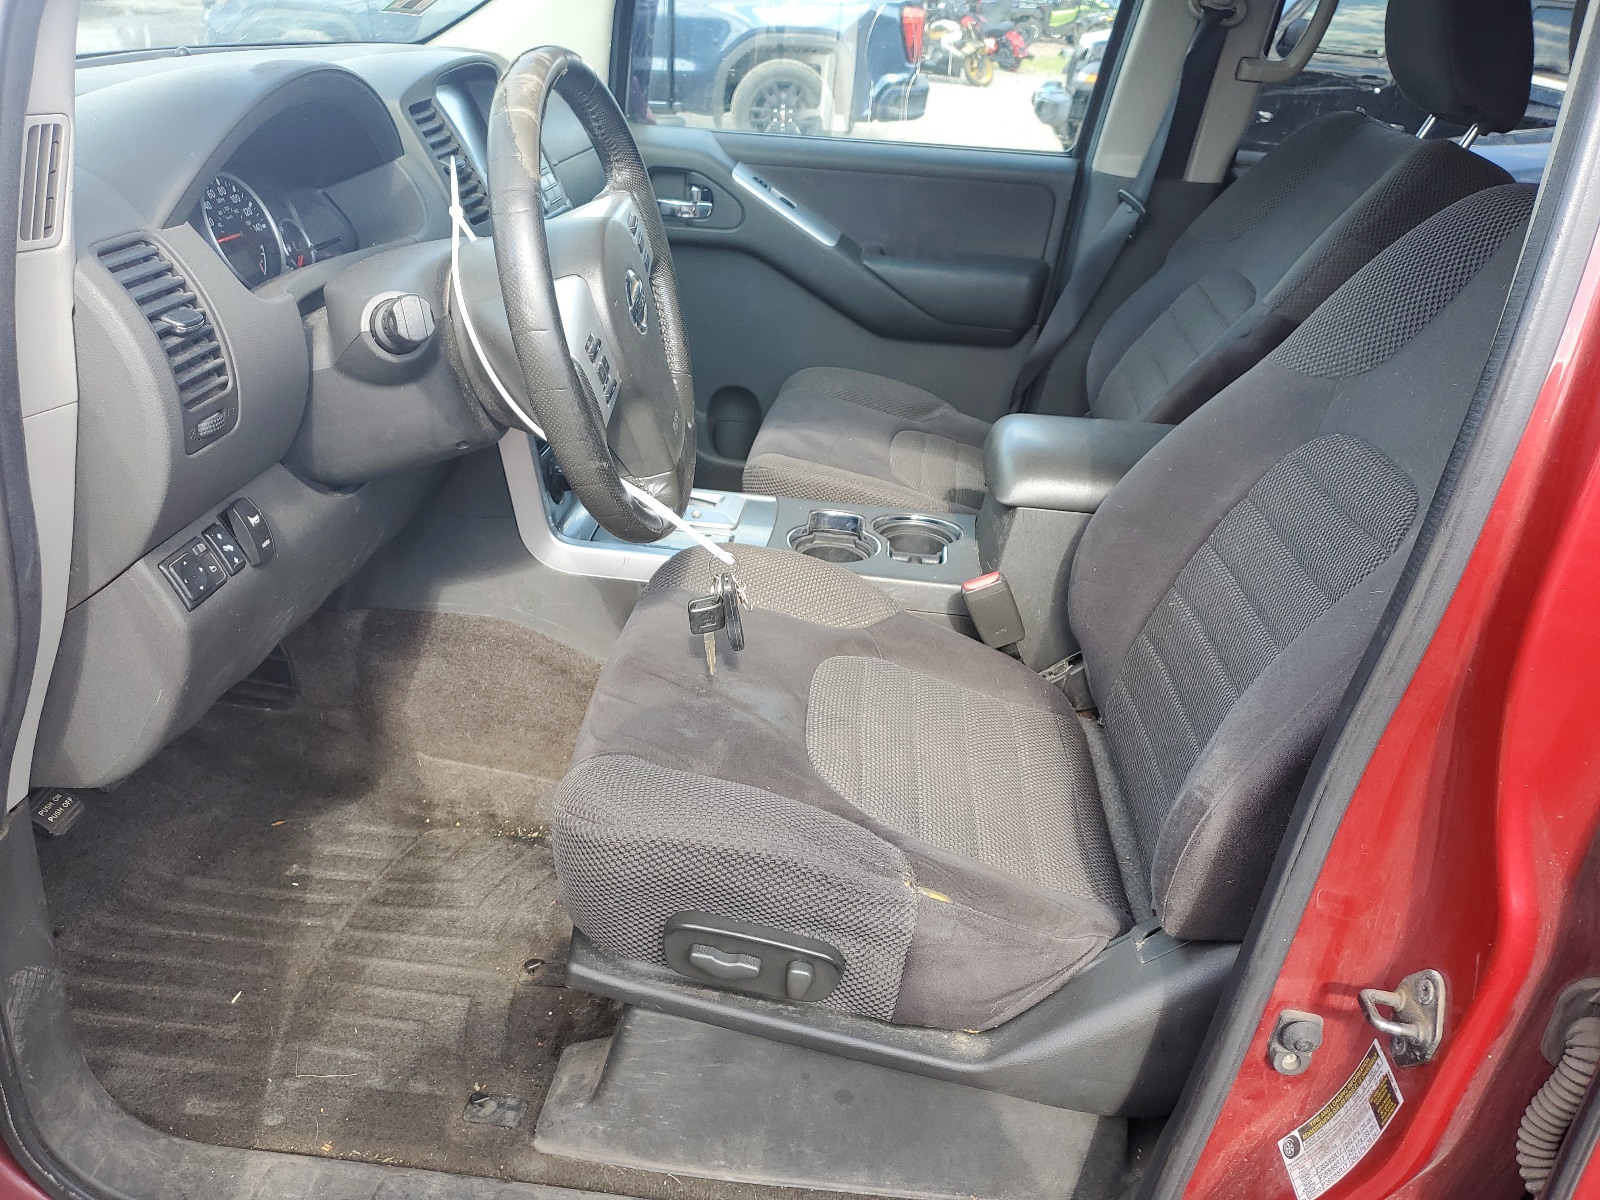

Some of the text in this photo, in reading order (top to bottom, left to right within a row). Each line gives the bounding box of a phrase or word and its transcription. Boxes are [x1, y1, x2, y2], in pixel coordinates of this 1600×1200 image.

[207, 189, 215, 198] 60
[230, 194, 241, 203] 100
[243, 207, 252, 216] 120
[253, 222, 262, 232] 140
[38, 794, 62, 816] PUSH ON
[48, 796, 73, 822] PUSH OFF
[1309, 1115, 1320, 1128] TIRE
[1319, 1105, 1331, 1119] AND
[1329, 1087, 1349, 1109] LOADING
